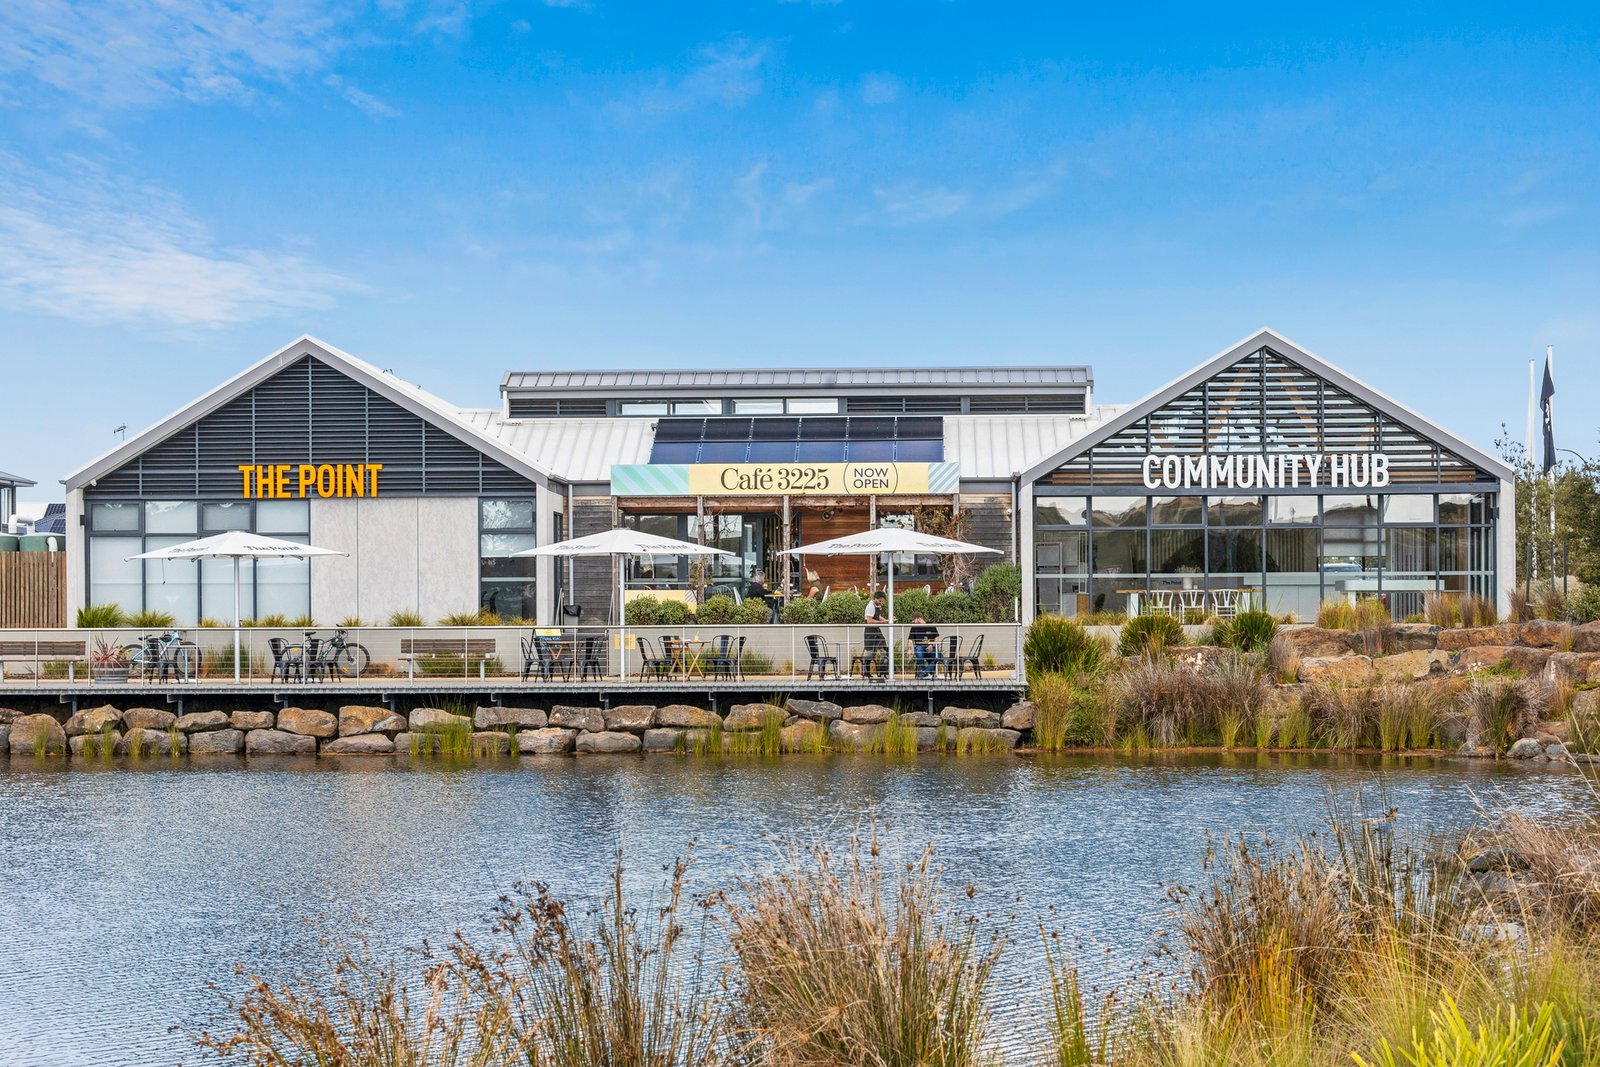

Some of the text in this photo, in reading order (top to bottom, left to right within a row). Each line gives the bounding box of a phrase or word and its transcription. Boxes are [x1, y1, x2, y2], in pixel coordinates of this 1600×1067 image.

[238, 463, 383, 499] THE POINT
[720, 467, 829, 490] Café 3225
[853, 467, 889, 478] NOW
[1142, 453, 1390, 489] COMMUNITY HUB
[853, 478, 889, 489] OPEN
